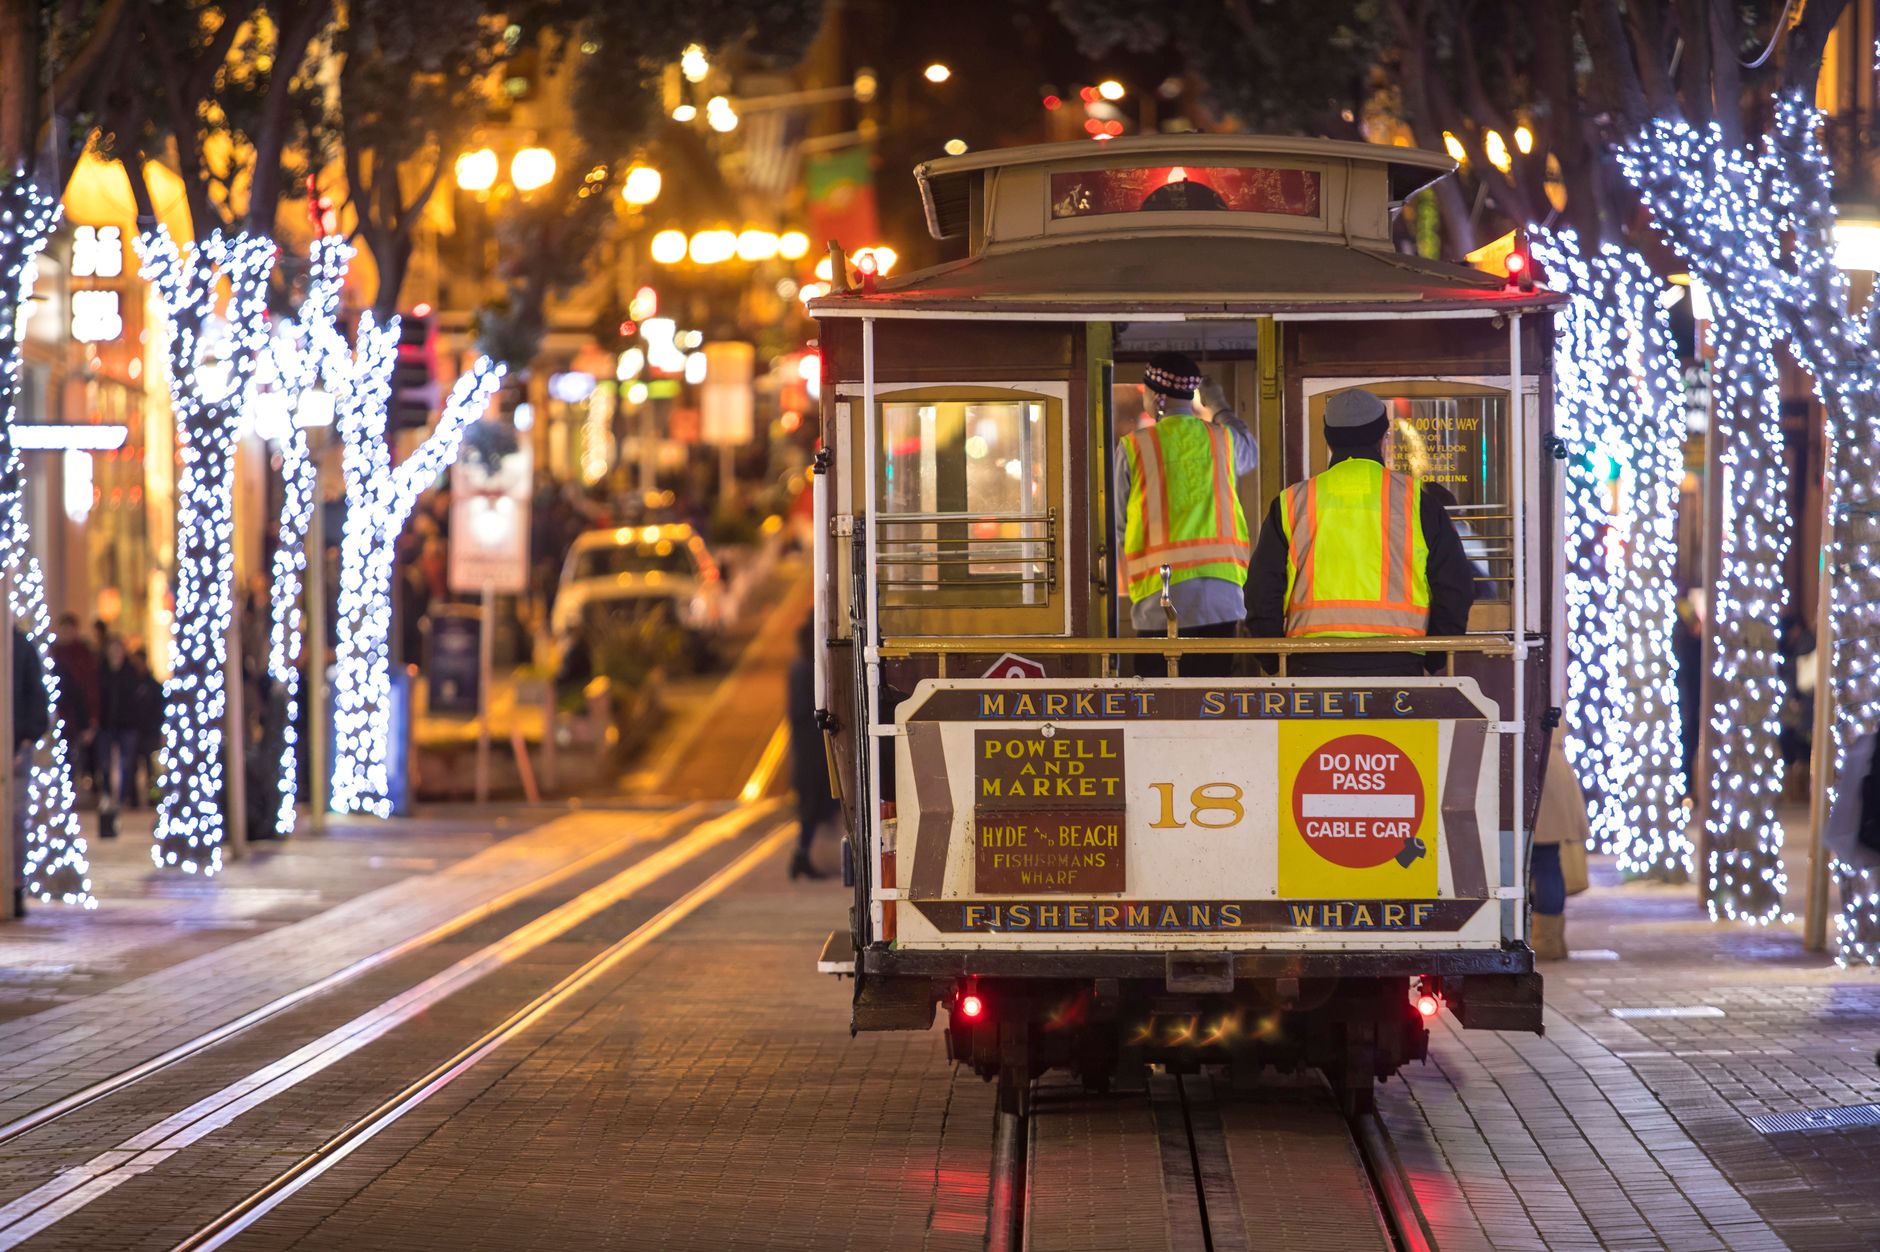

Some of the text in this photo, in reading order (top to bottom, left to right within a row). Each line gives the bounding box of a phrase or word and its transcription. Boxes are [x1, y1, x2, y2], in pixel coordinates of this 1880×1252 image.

[1431, 418, 1453, 430] ONE
[1456, 418, 1479, 430] WAY
[979, 693, 1155, 718] MARKET
[1200, 691, 1373, 717] STREET
[984, 739, 1117, 759] POWELL
[1020, 761, 1085, 775] AND
[1319, 754, 1399, 771] DO NOT
[982, 777, 1120, 796] MARKET
[1332, 773, 1386, 790] PASS
[1148, 782, 1245, 829] 18
[983, 825, 1028, 848] HYDE
[1059, 825, 1118, 847] BEACH
[1306, 821, 1411, 838] CABLE CAR
[1021, 870, 1078, 885] WHARF
[962, 903, 1434, 930] FISHERMANS WHARF
